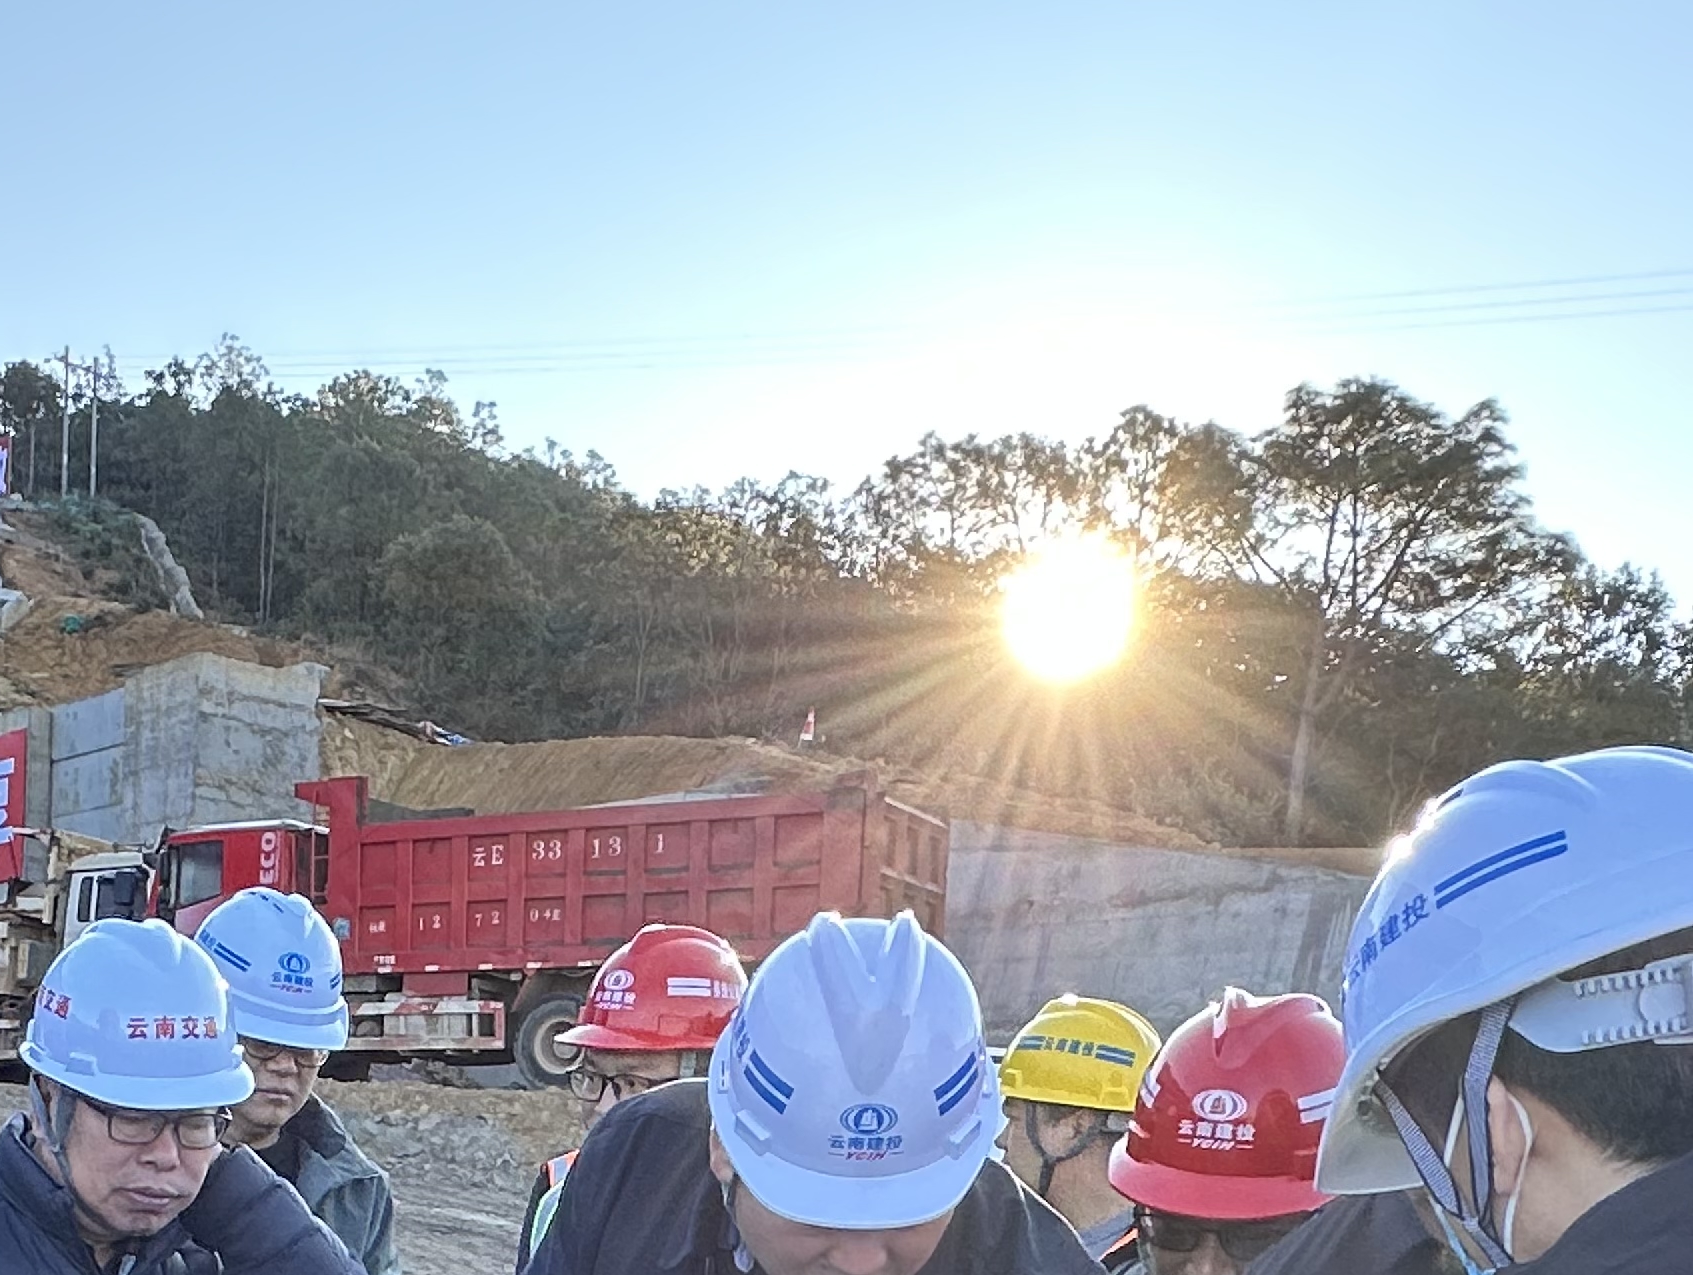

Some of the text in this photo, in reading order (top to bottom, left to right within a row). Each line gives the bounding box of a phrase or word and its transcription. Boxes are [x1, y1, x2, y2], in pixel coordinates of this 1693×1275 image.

[126, 1015, 218, 1039] 云南交通
[1178, 1119, 1256, 1141] 云南建投
[828, 1135, 902, 1151] 云南建投
